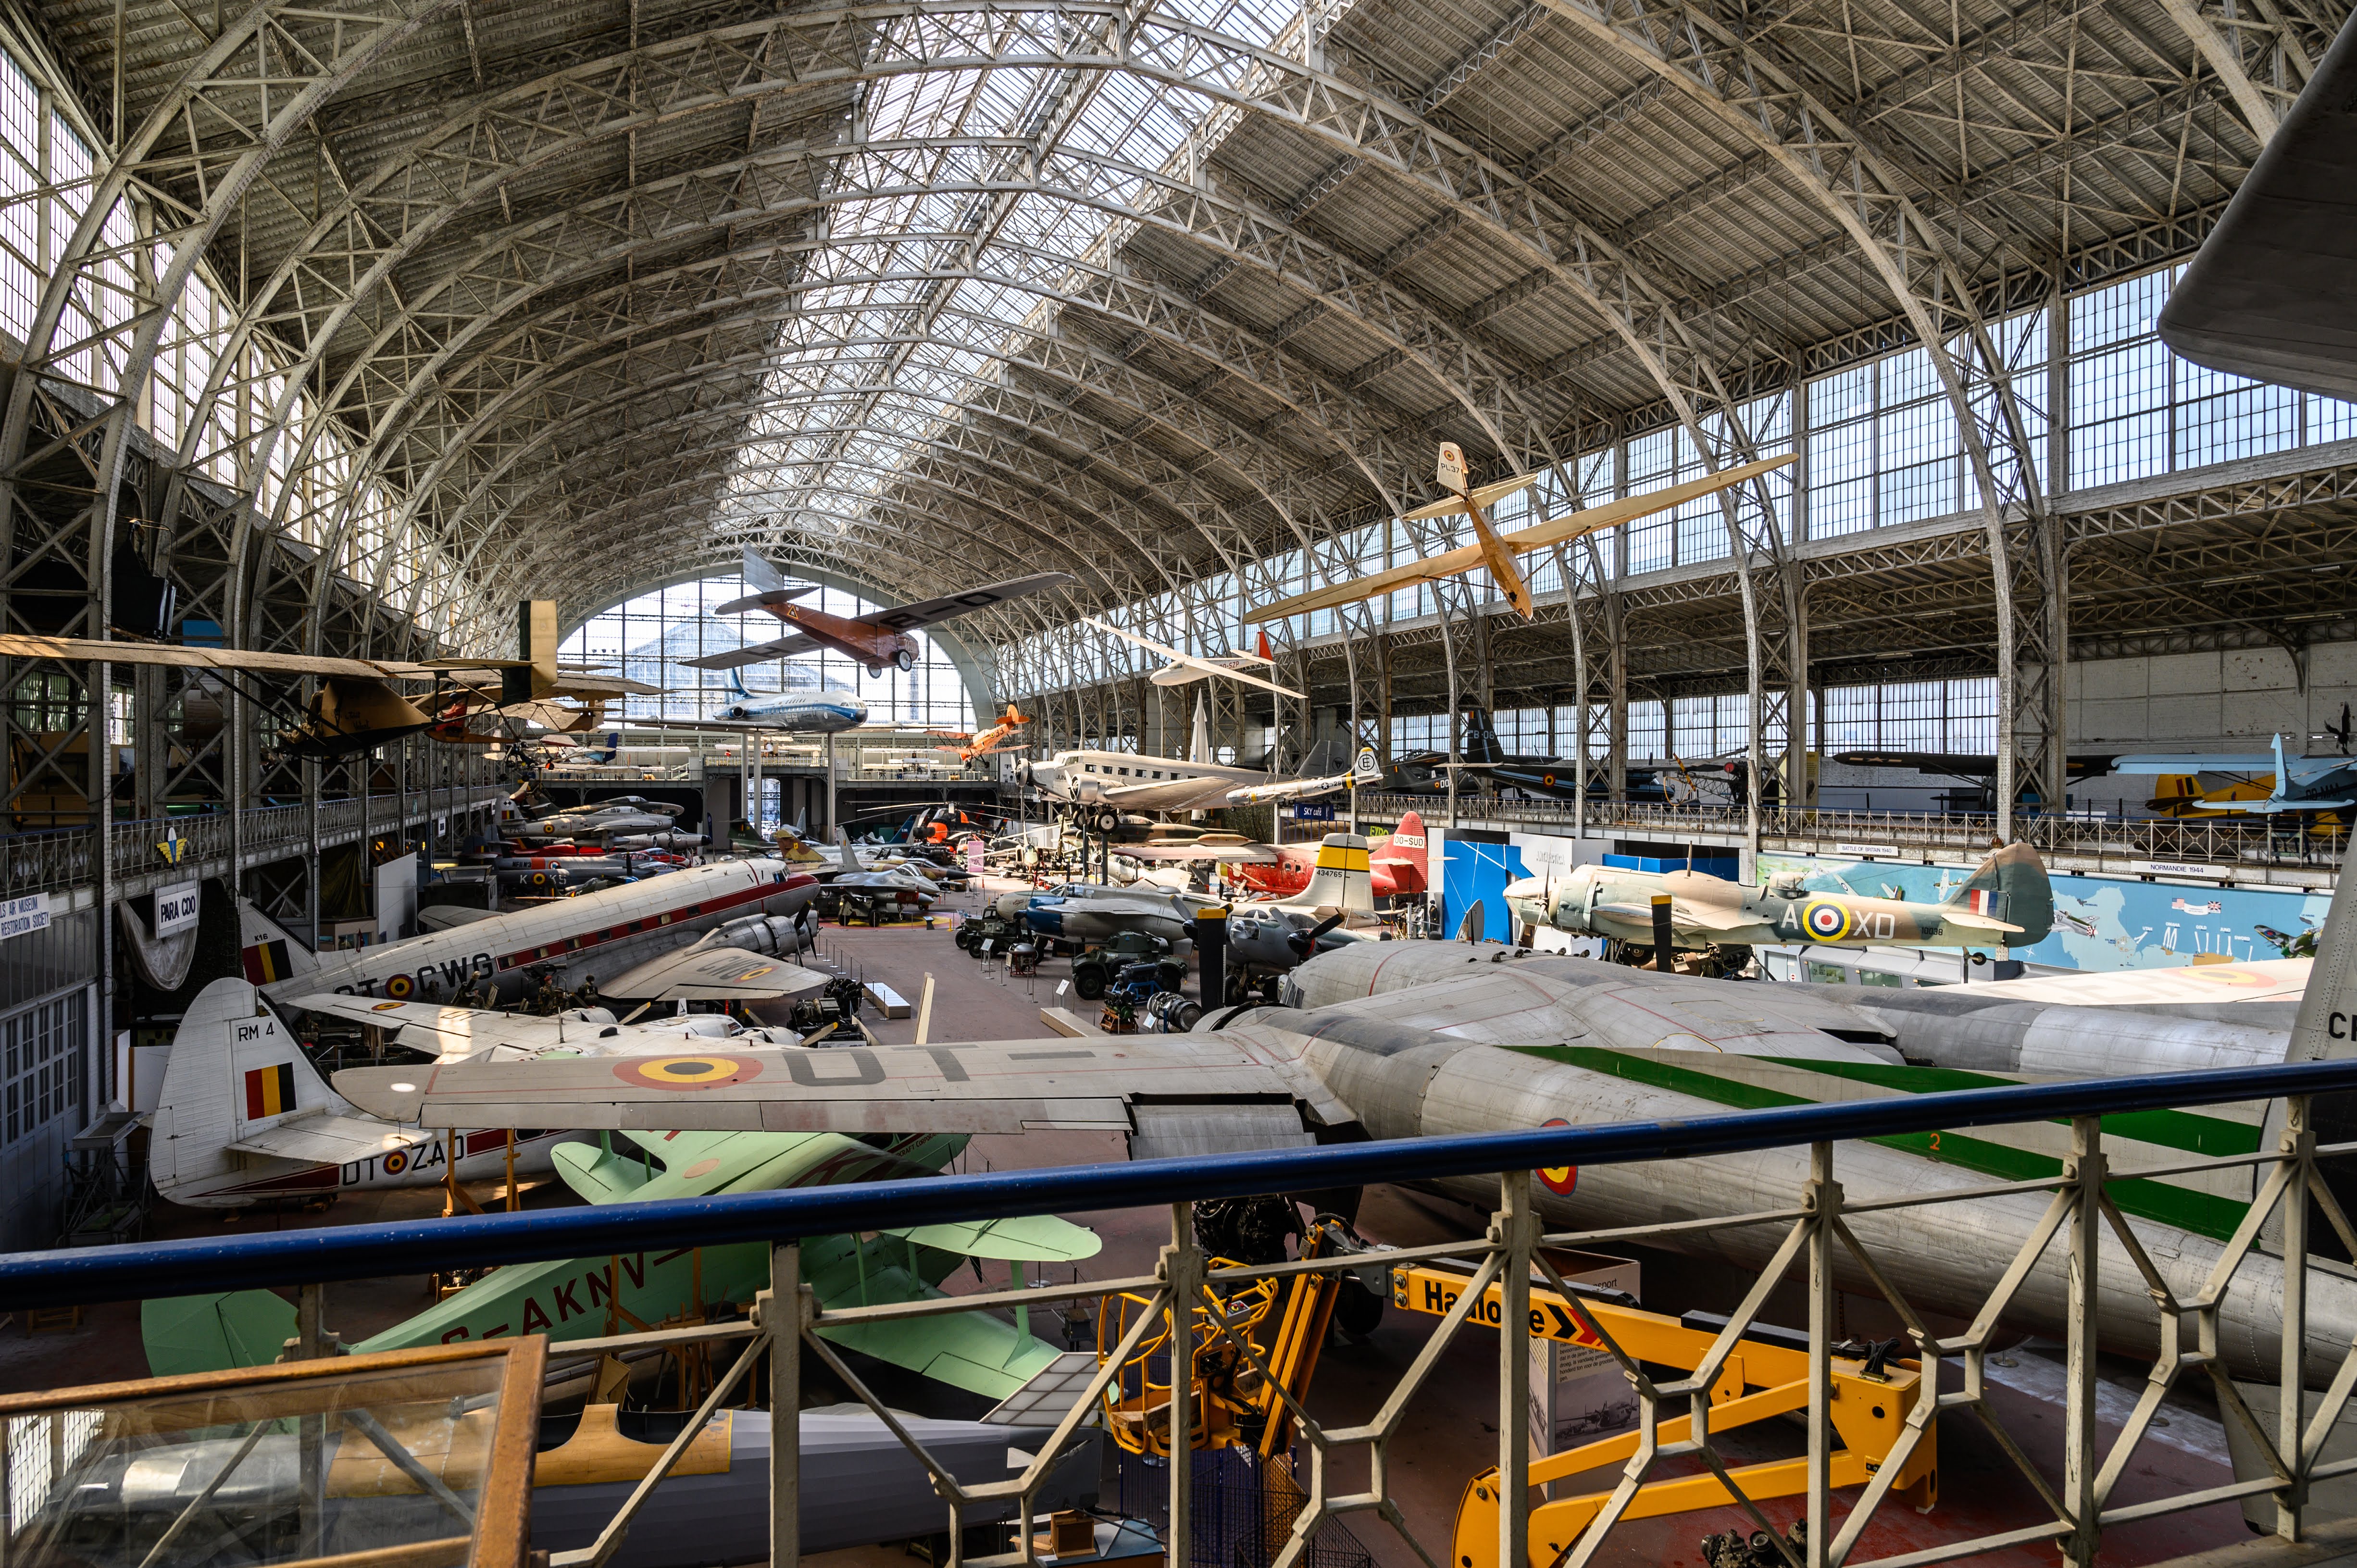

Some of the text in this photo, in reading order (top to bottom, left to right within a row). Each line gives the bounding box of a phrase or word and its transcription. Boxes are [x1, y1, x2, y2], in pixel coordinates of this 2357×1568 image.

[1304, 807, 1313, 816] SKY
[1313, 807, 1322, 816] café
[1370, 826, 1389, 836] EXPO
[1395, 836, 1424, 846] OO-SUD
[520, 874, 528, 884] K
[18, 896, 38, 913] MUSEUM
[161, 895, 196, 923] PARA CDO
[1, 911, 49, 936] RESTORATION SOCIETY
[1781, 903, 1896, 939] A XD
[254, 933, 268, 942] K16
[238, 1022, 274, 1042] RM 4
[1930, 1132, 1940, 1150] 2
[1599, 1357, 1614, 1365] grootste
